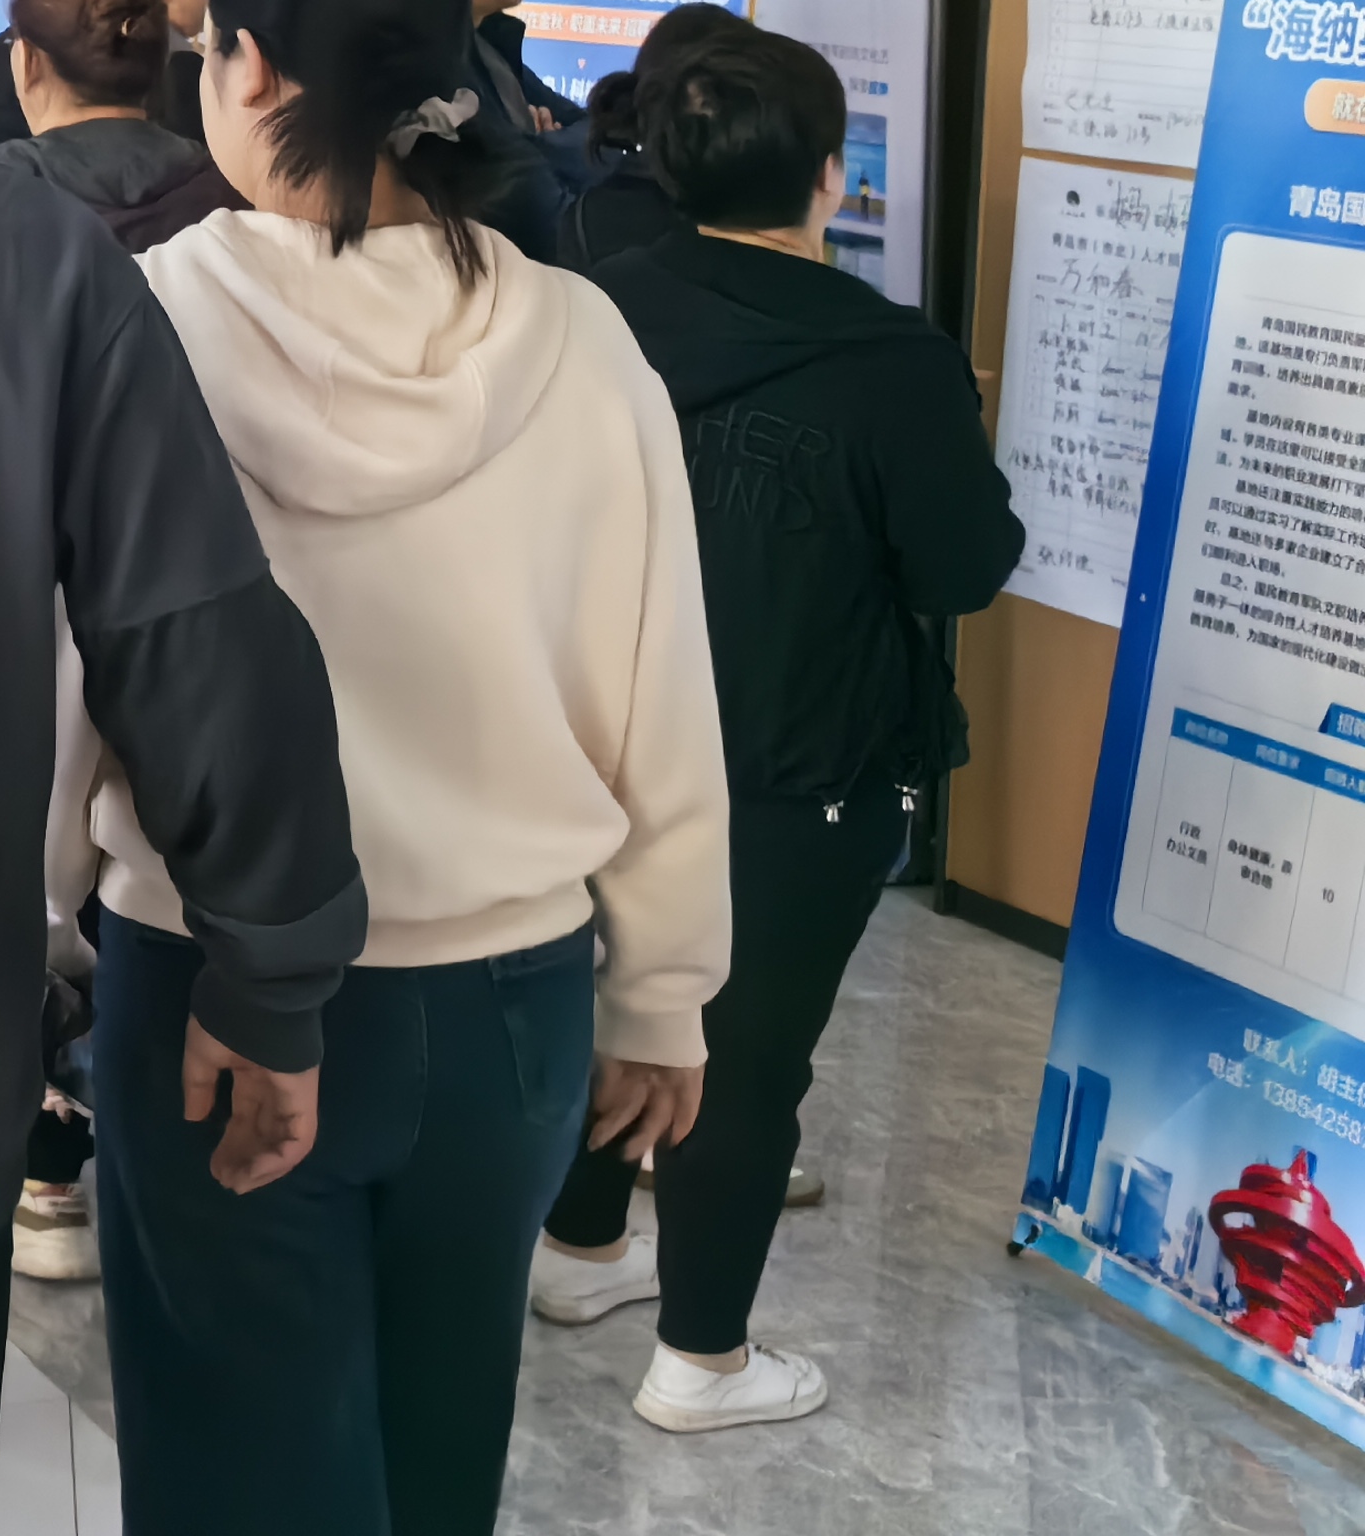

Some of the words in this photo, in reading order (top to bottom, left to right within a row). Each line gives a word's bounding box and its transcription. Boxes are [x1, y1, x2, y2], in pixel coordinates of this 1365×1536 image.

[1288, 183, 1365, 227] 青岛国
[1321, 887, 1336, 905] 10
